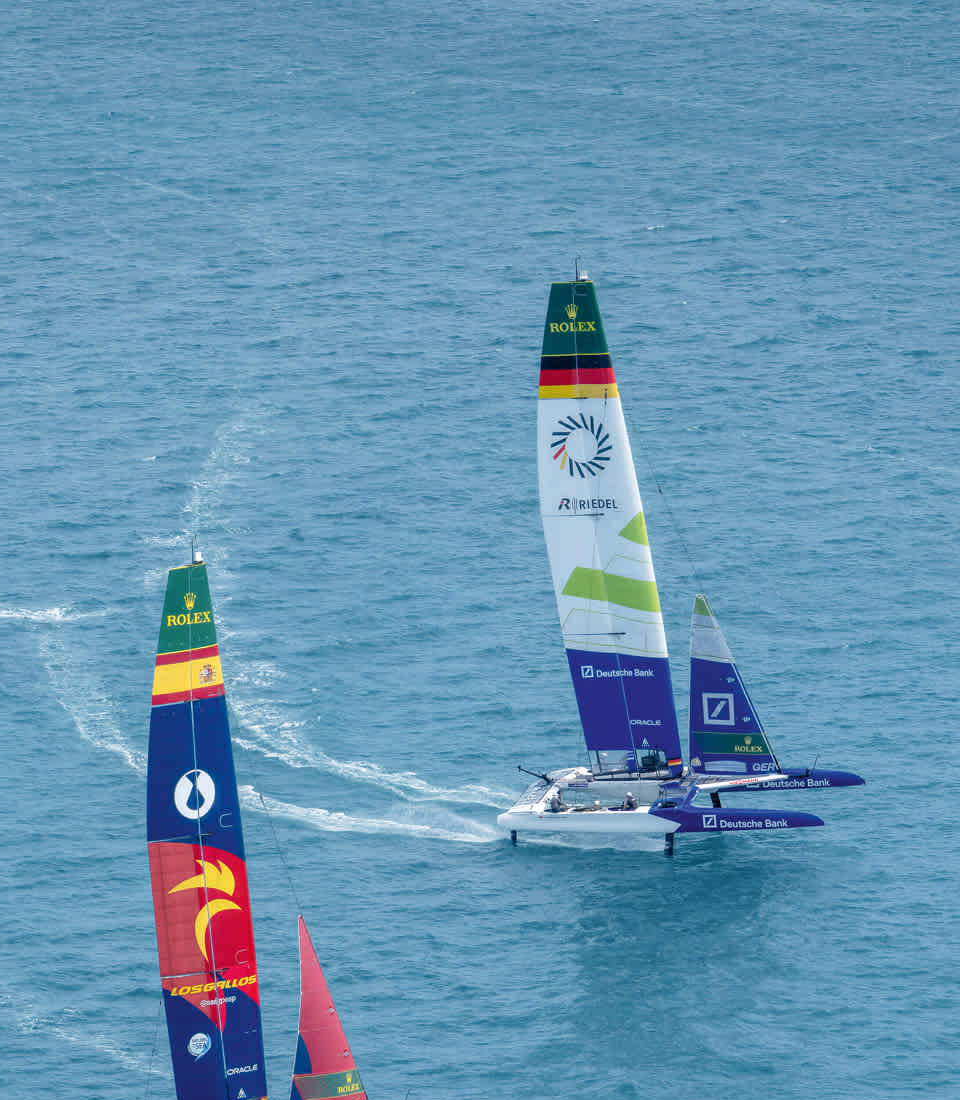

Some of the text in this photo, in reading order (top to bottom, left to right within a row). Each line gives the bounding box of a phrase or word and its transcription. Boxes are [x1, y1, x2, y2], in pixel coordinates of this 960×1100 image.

[549, 321, 597, 333] ROLEX
[579, 499, 618, 510] RIEDEL
[166, 611, 211, 627] ROLEX
[596, 668, 654, 678] Deutsche Bank
[734, 745, 763, 753] ROLEX
[807, 778, 830, 787] Bank
[719, 819, 788, 829] Deutsche Bank
[226, 1064, 258, 1076] ORACLE
